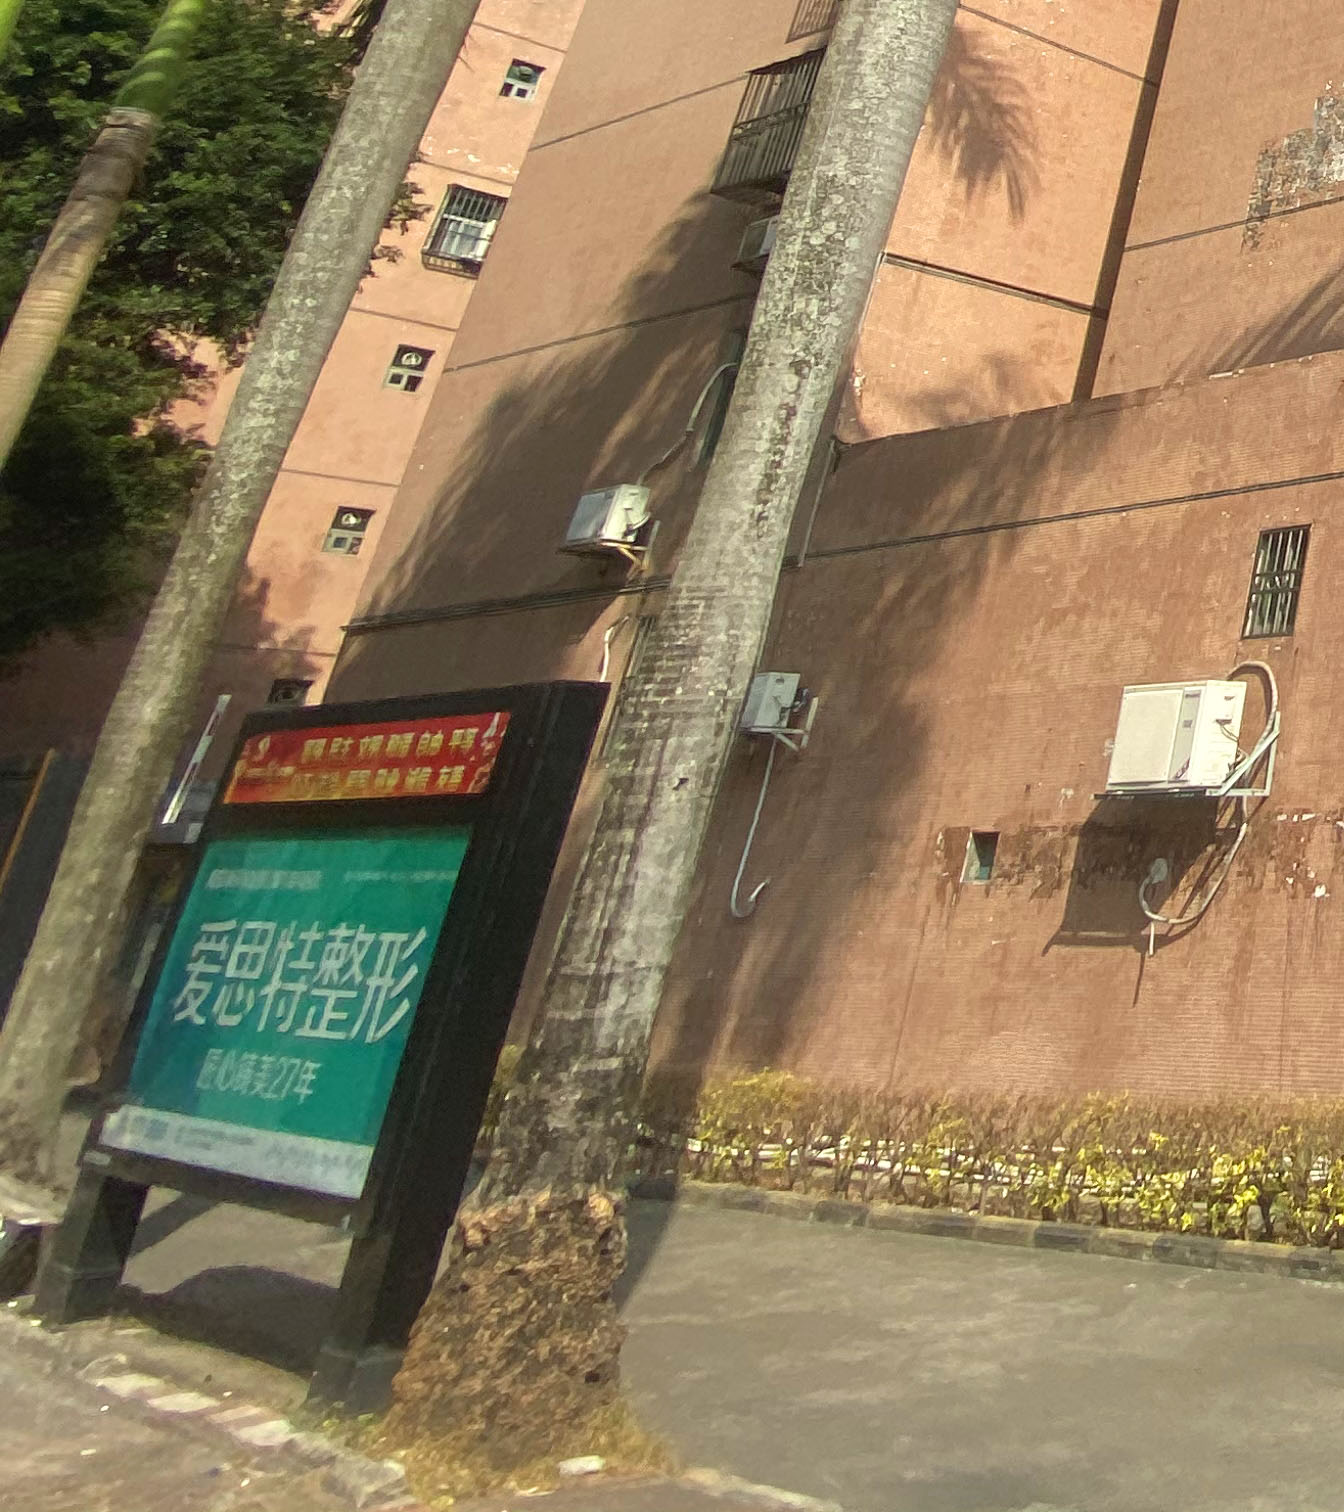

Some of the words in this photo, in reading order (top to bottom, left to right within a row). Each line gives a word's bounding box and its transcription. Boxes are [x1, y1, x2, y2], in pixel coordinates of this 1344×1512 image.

[173, 919, 428, 1044] 爱思特整形
